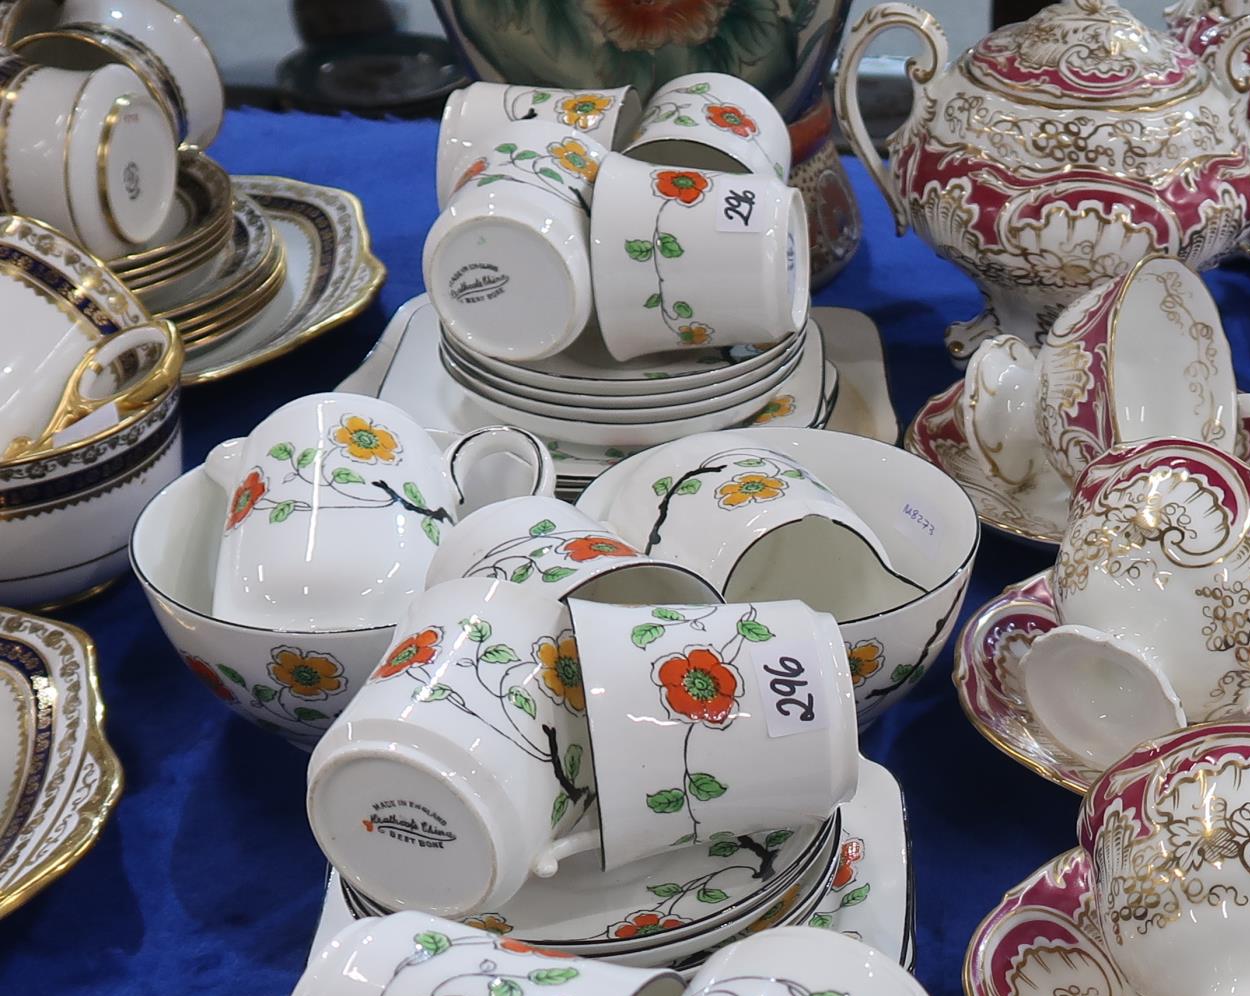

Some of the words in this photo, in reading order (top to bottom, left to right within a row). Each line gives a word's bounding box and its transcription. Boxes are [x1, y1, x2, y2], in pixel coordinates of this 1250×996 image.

[724, 189, 756, 226] 296
[763, 656, 815, 722] 296
[372, 799, 396, 812] MADE
[408, 801, 448, 826] ENGLAND
[389, 830, 416, 844] BEST
[418, 840, 444, 849] BONE
